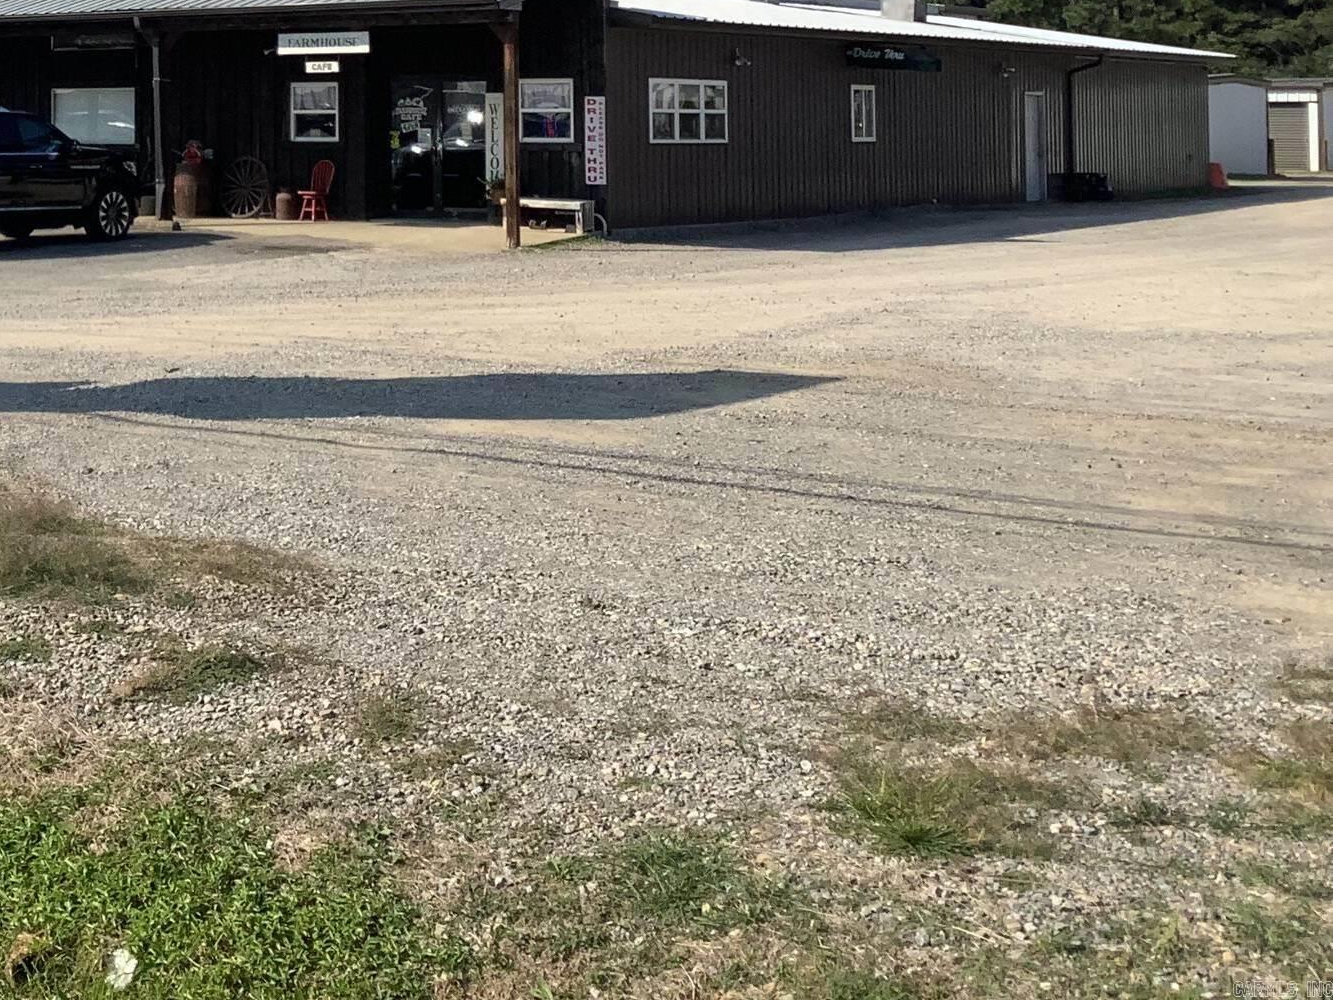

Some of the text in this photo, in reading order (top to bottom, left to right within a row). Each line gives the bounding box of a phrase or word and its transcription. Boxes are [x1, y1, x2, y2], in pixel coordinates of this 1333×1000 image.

[288, 37, 359, 48] FARMHOUSE
[489, 103, 500, 183] WELCOM
[587, 98, 598, 182] DRIVE THRU
